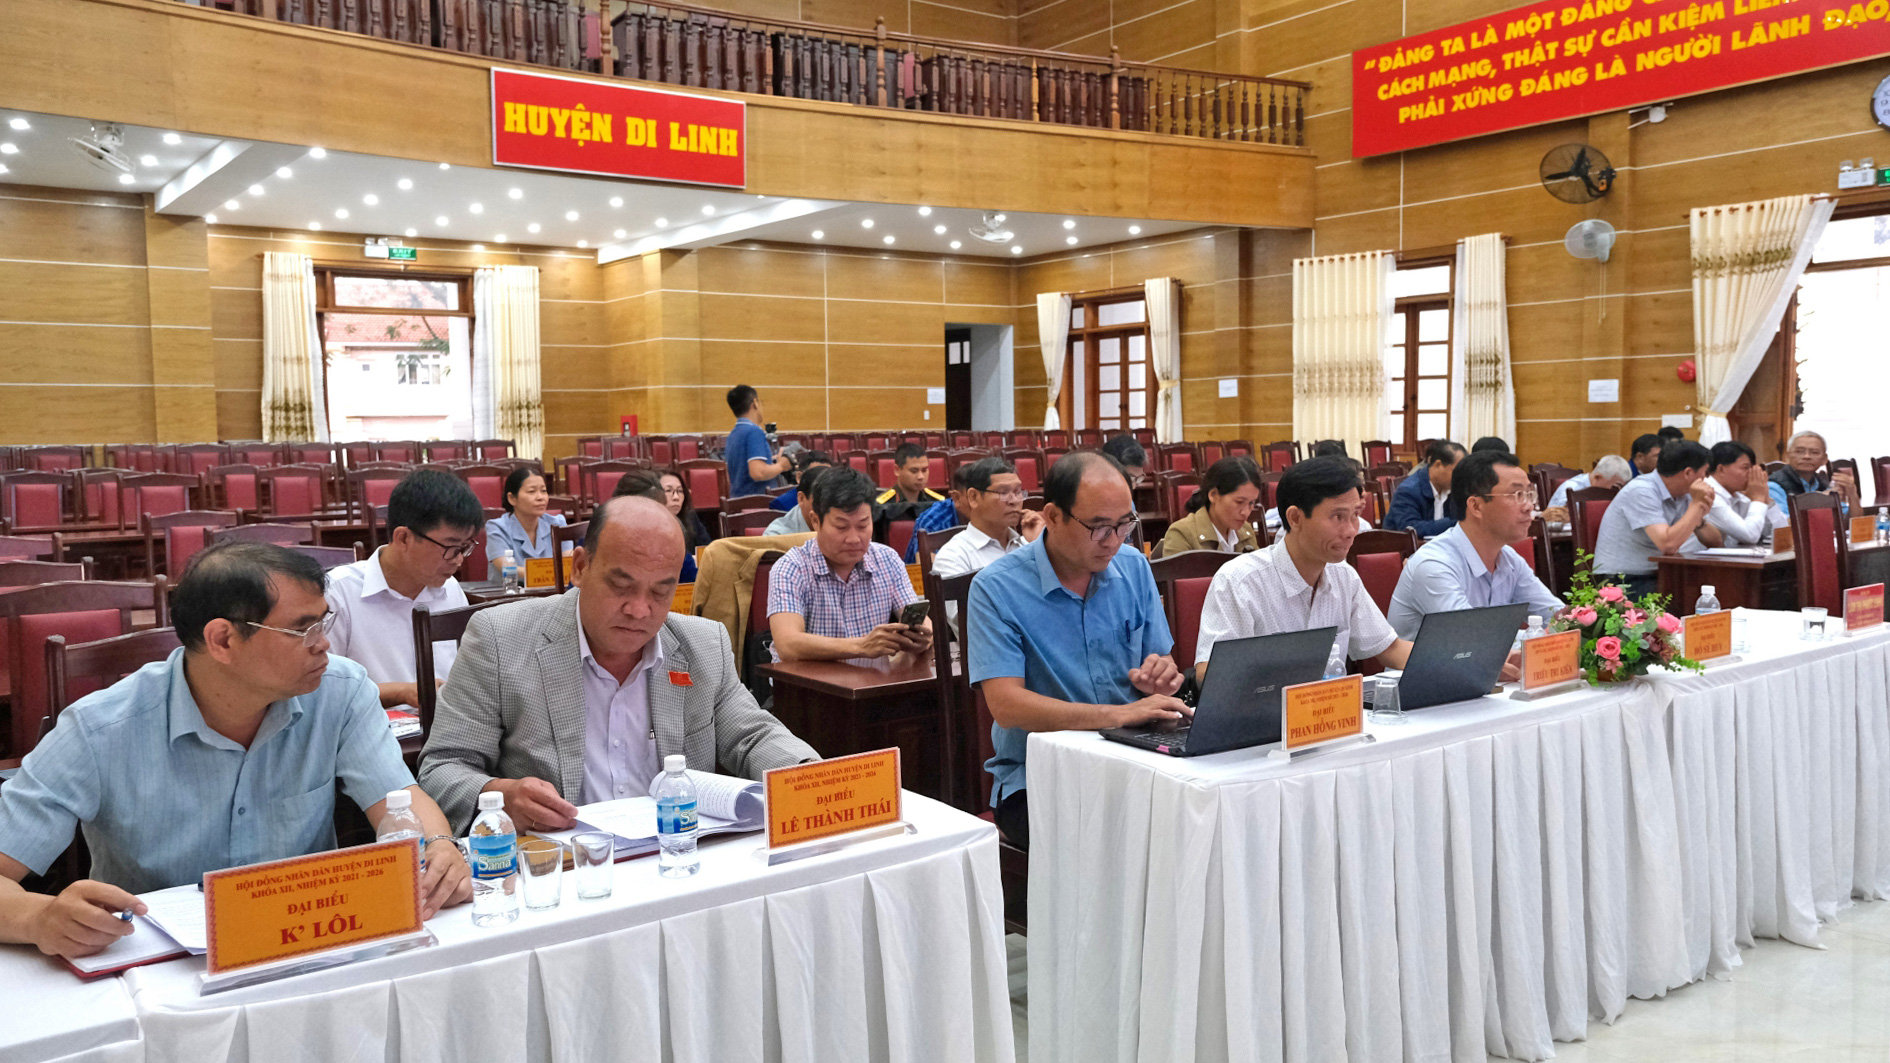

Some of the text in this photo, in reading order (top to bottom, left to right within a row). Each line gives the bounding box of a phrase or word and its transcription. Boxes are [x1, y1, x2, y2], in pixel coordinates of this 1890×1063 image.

[1441, 36, 1466, 57] TA
[1471, 24, 1499, 49] LÀ
[1505, 11, 1555, 41] MỘT
[1377, 77, 1425, 101] CÁCH
[1428, 58, 1497, 87] MẠNG,
[1502, 40, 1559, 70] THẬT
[1563, 29, 1597, 57] SỰ
[1601, 17, 1652, 47] CẦN
[1658, 2, 1725, 34] KIỆM
[1398, 95, 1445, 124] PHẢI
[1451, 83, 1514, 113] XỨNG
[1519, 66, 1589, 97] ĐÁNG
[1595, 54, 1627, 81] LÀ
[1636, 33, 1721, 72] NGƯỜI
[1731, 14, 1811, 51] LÃNH
[504, 101, 738, 157] HUYỆN DI LINH
[1453, 651, 1472, 660] ASUS
[1290, 716, 1357, 739] PHAN HỒNG VINH
[816, 787, 855, 806] ĐẠI BIỂU
[781, 798, 891, 835] LÊ THÀNH THÁI
[236, 855, 397, 892] HỘI ĐỒNG NHÂN DÂN HUYỆN DI LINH
[251, 886, 278, 899] KHÓA
[279, 885, 295, 893] XII,
[297, 878, 327, 889] NHIỆM
[342, 872, 359, 882] 2021
[367, 869, 384, 878] 2026
[287, 889, 349, 915] ĐẠI BIỂU
[313, 914, 363, 939] LÔL
